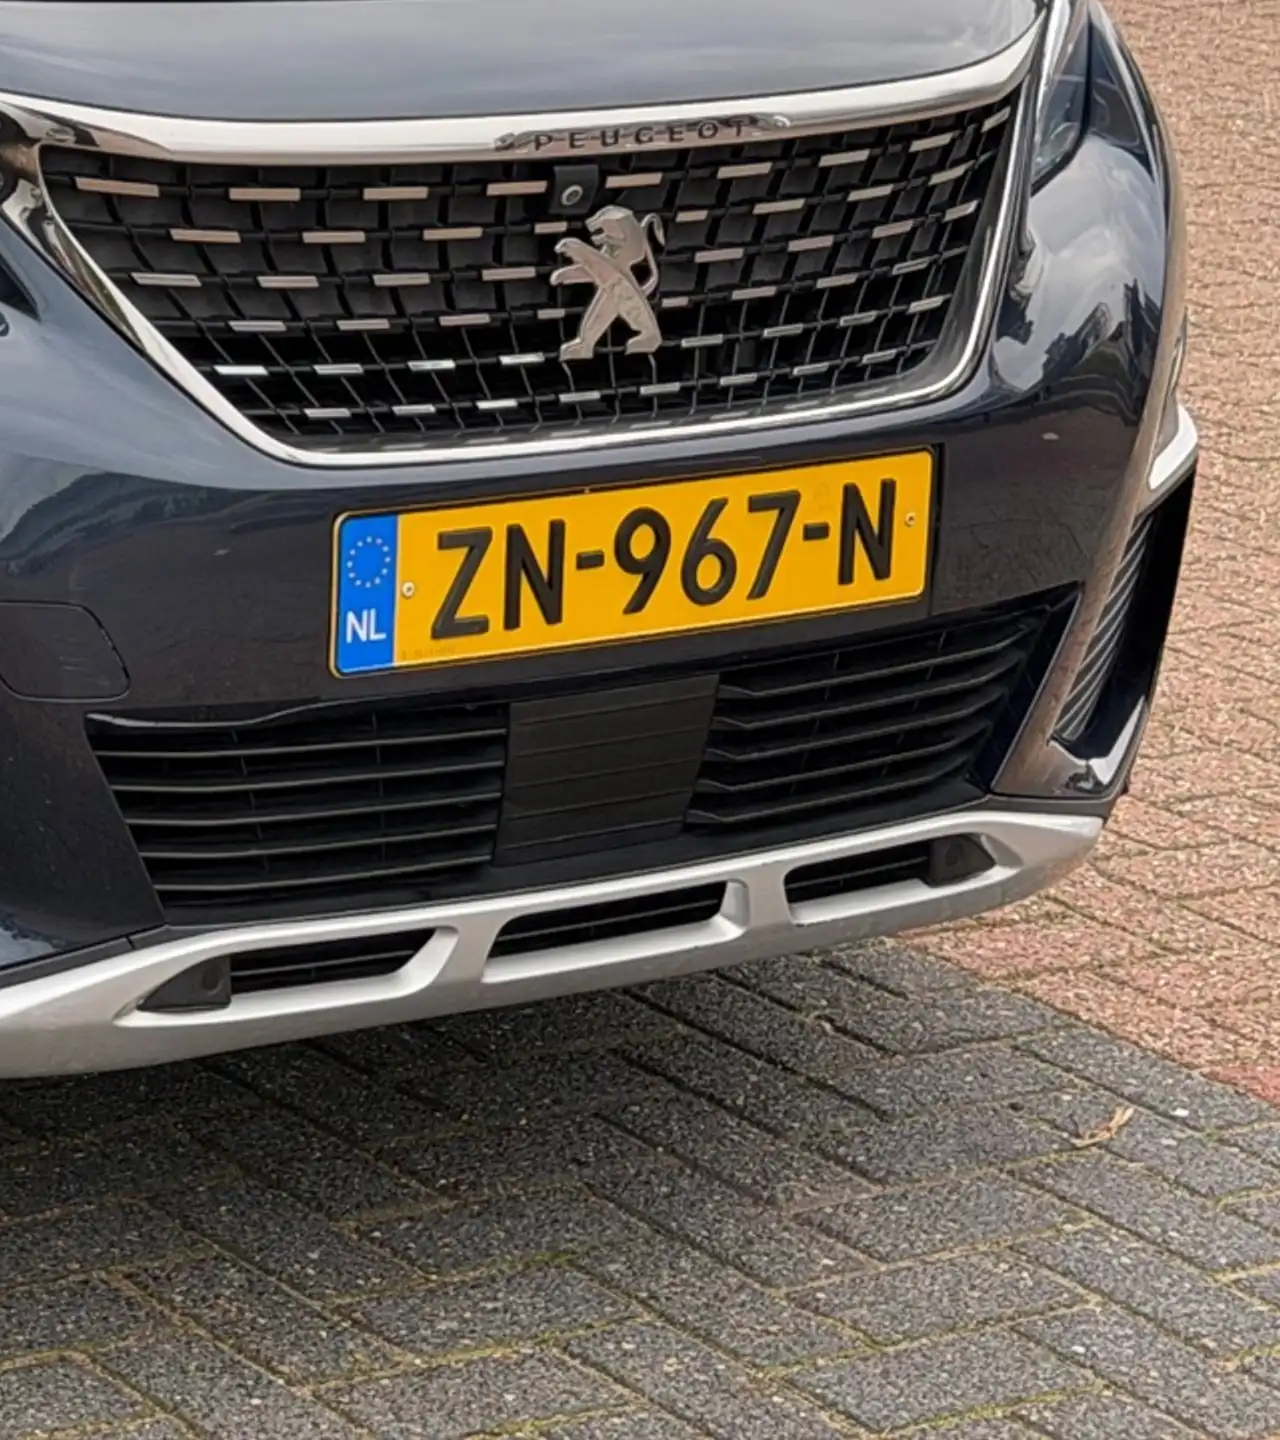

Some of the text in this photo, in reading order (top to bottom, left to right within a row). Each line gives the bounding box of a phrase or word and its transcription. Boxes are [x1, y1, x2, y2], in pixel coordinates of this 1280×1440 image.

[534, 116, 749, 151] PEUGEOT
[430, 478, 897, 641] ZN-967-N
[345, 608, 387, 644] NL
